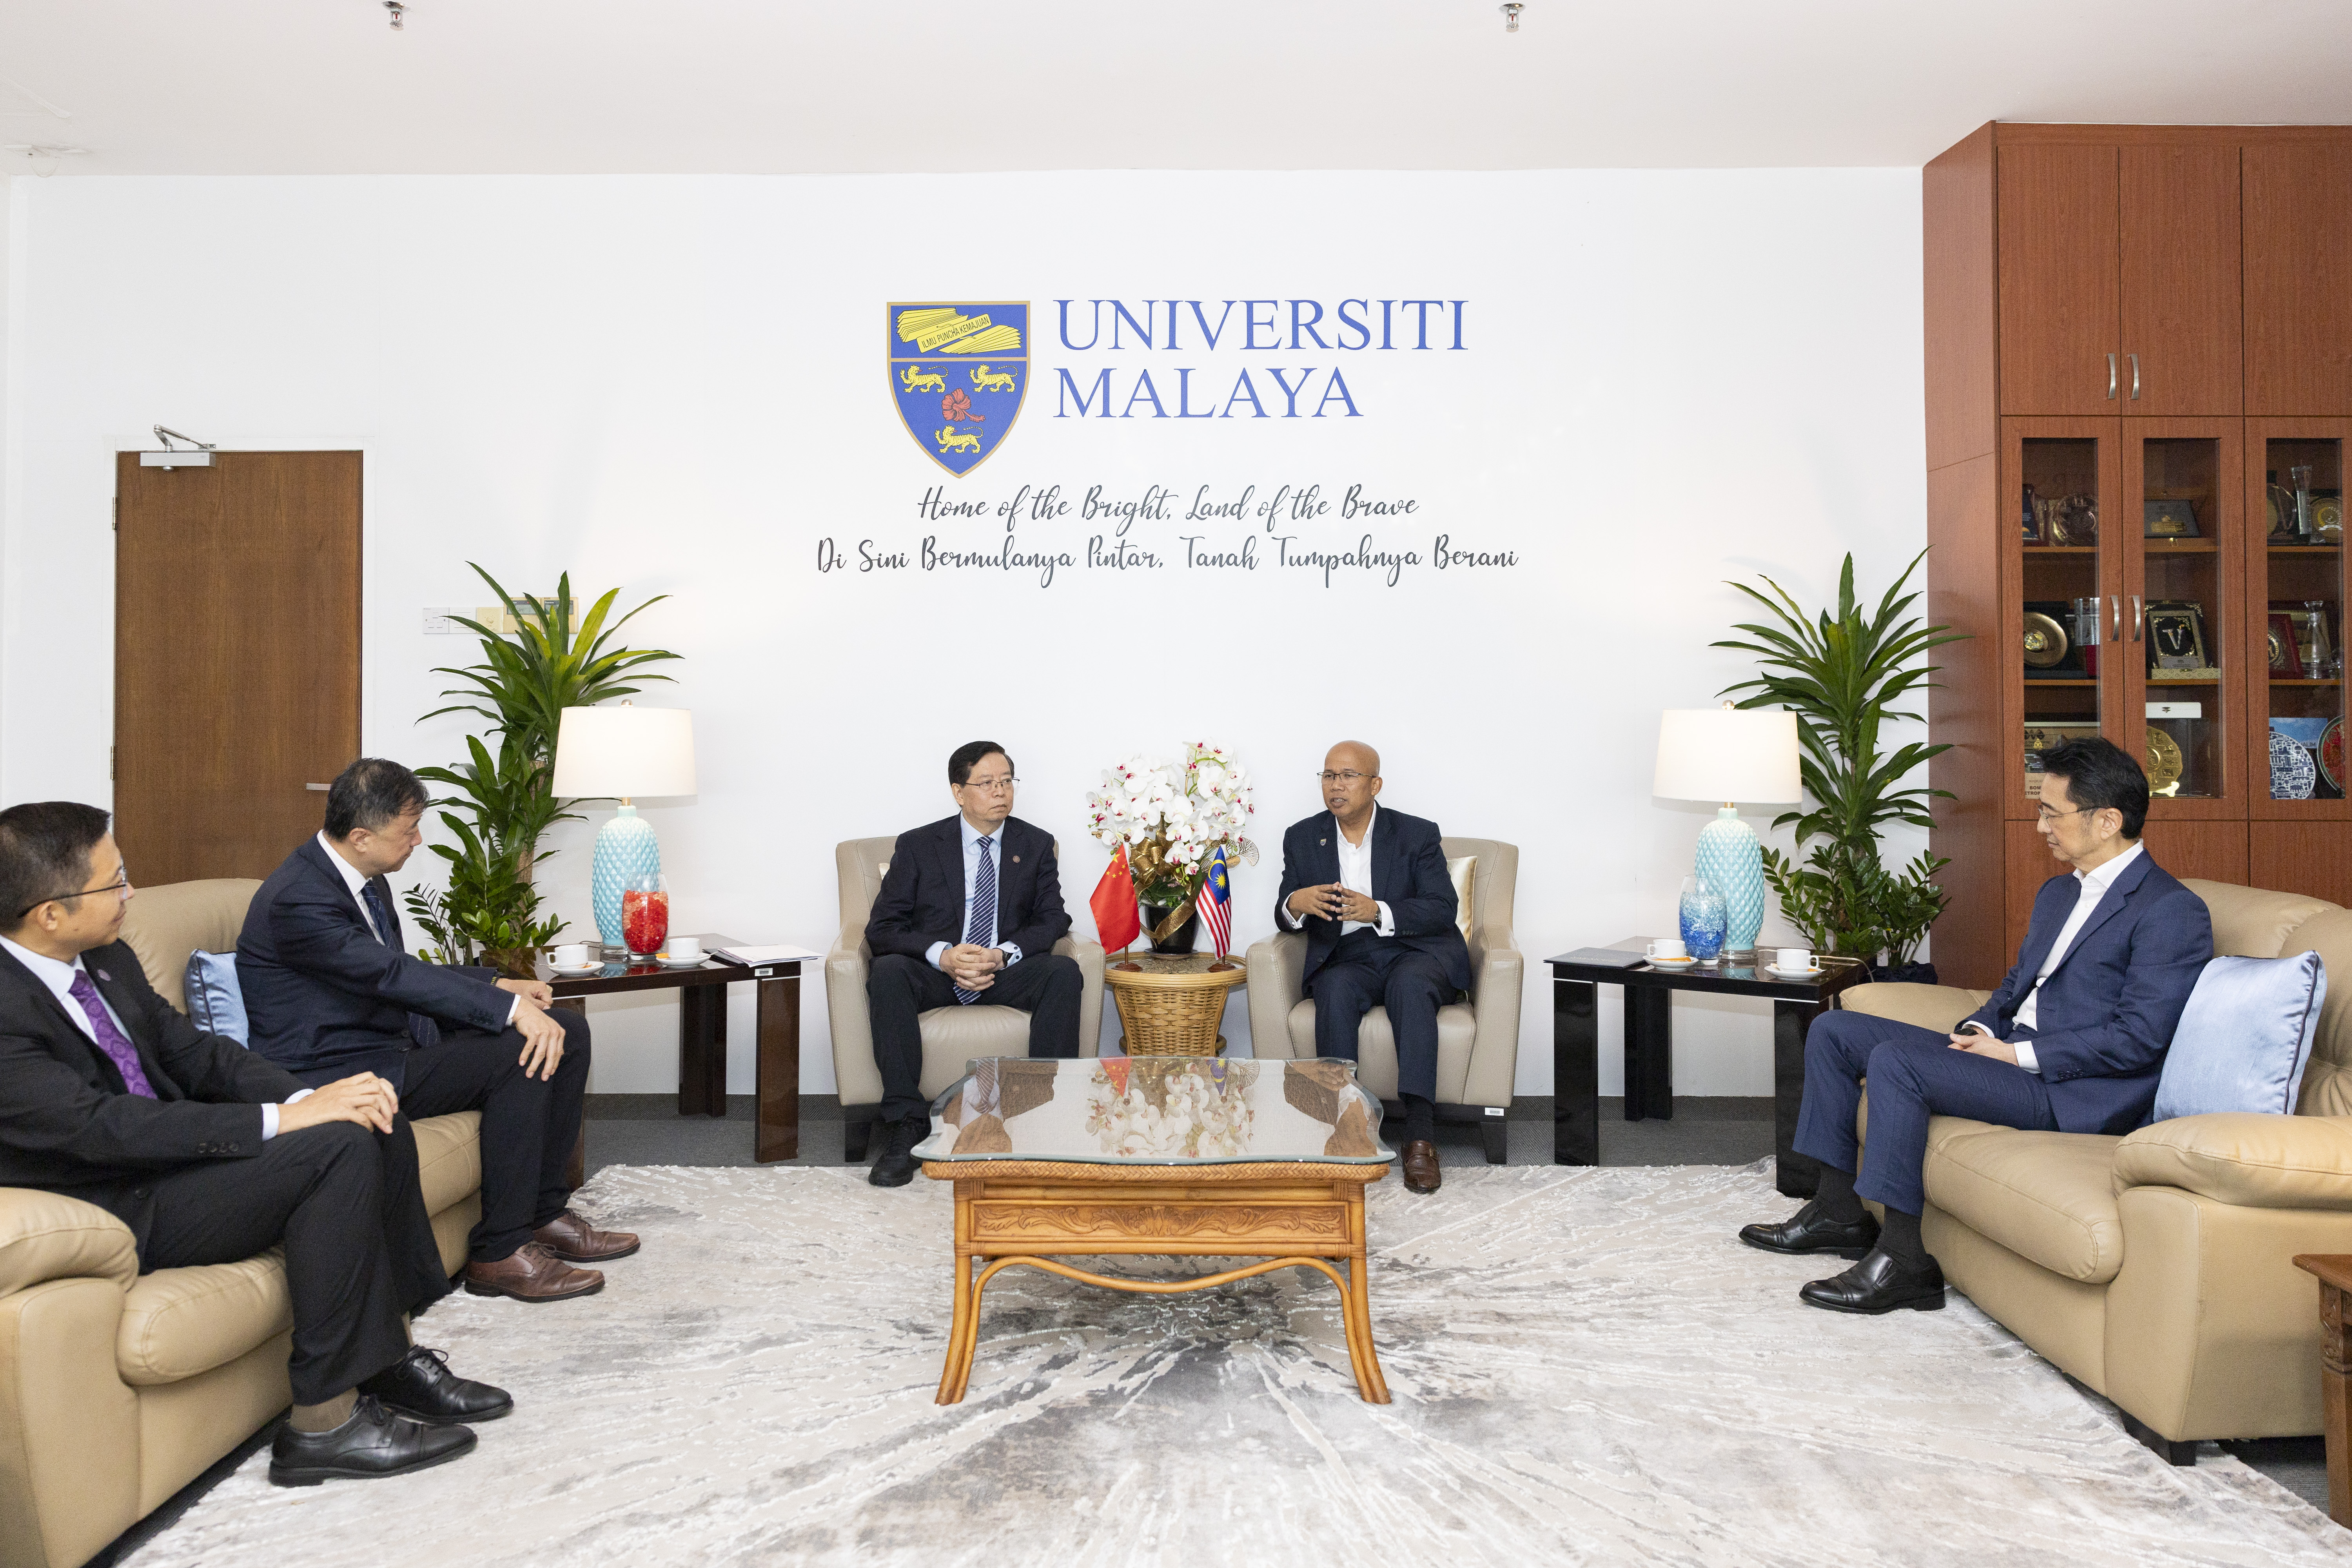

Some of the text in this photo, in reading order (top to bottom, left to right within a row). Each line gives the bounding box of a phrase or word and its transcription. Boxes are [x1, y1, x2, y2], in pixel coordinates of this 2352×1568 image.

[922, 316, 989, 348] ILMU PUNCHA KEMAJUAN
[1053, 299, 1469, 351] UNIVERSITI
[1053, 367, 1364, 417] MALAYA
[918, 484, 1419, 537] Home of the Bright, Land of the Brave
[818, 534, 1519, 588] Di Sini Bermulanya Pintar, Tanah Tumpahnya Berani
